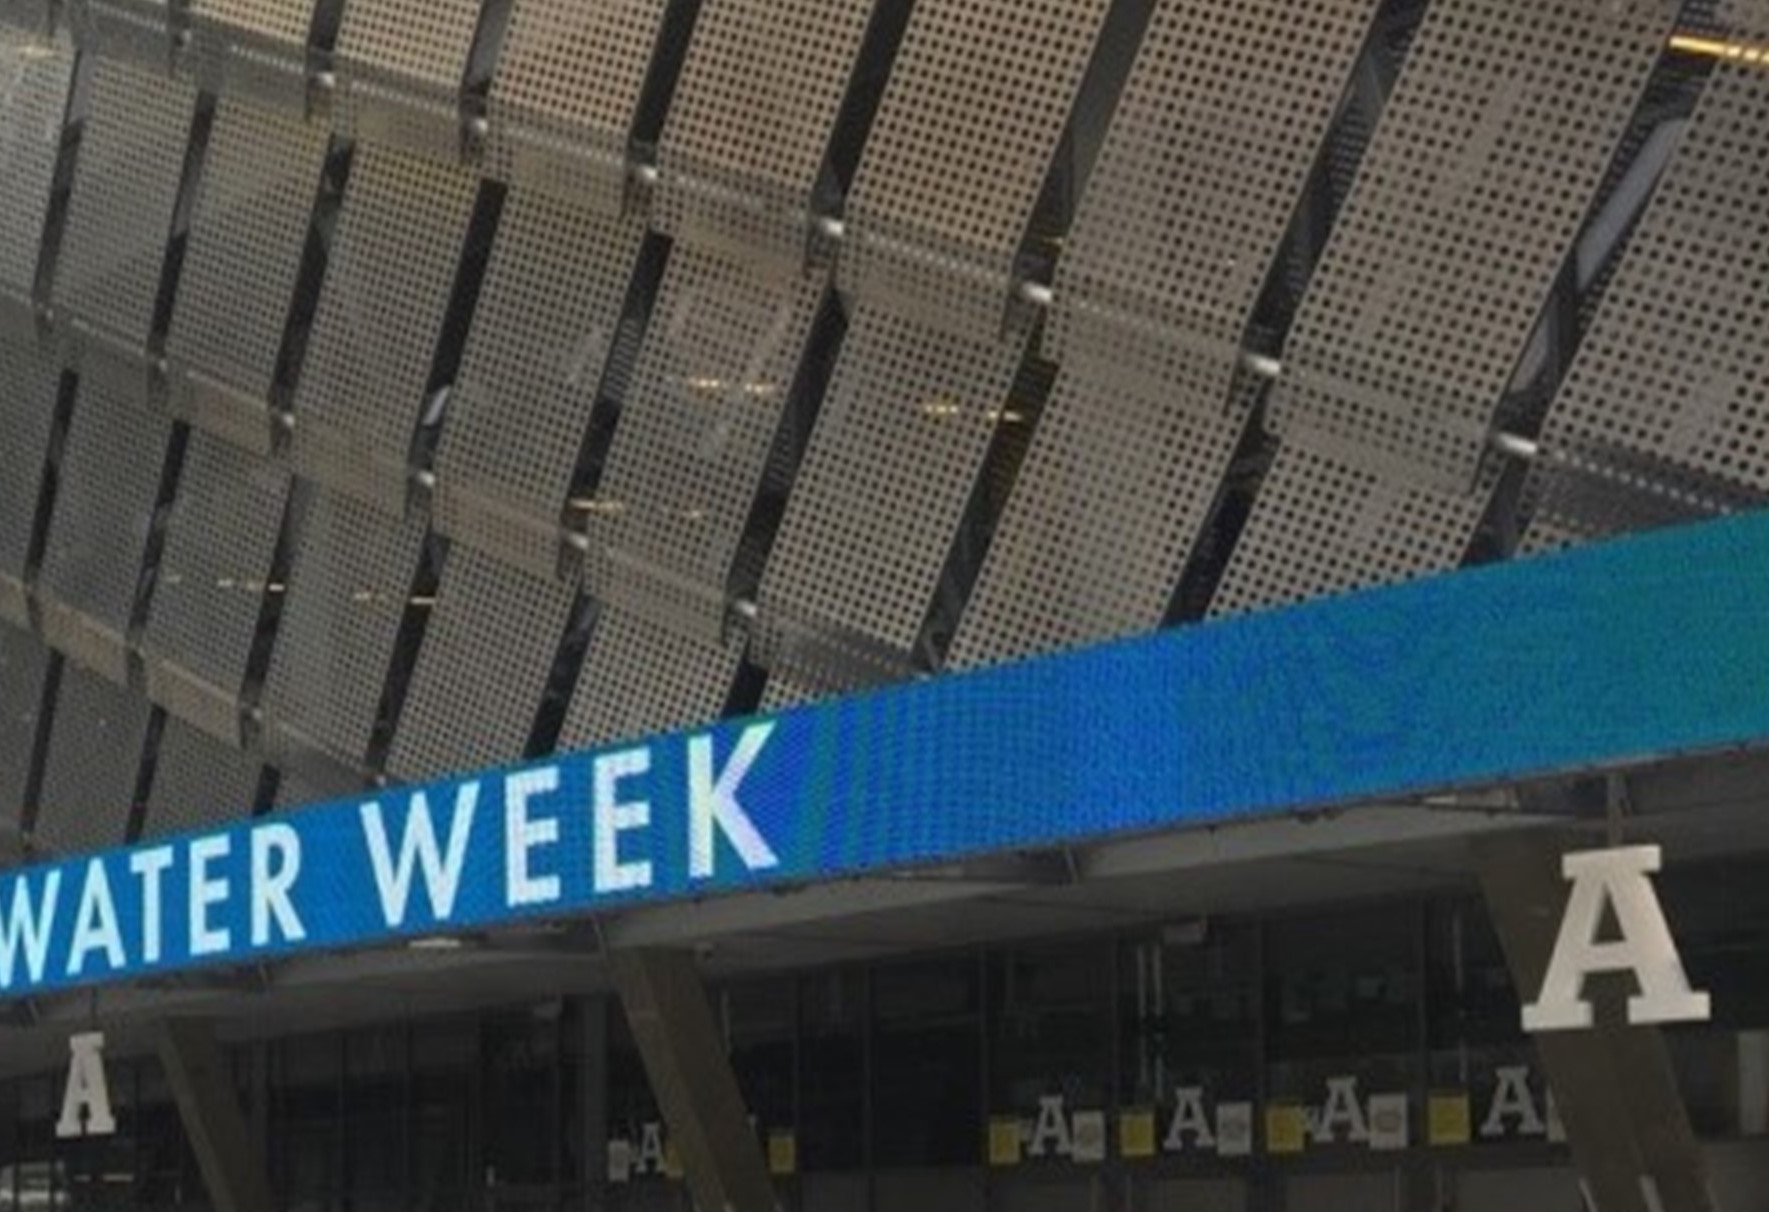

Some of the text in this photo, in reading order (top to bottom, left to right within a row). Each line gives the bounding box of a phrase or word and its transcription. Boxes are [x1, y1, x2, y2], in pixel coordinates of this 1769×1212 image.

[359, 718, 779, 927] WEEK
[1522, 845, 1711, 1032] A
[55, 1031, 116, 1138] A
[1163, 1087, 1215, 1149] A
[1313, 1075, 1370, 1143] A
[1481, 1066, 1546, 1136] A
[1028, 1095, 1071, 1156] A
